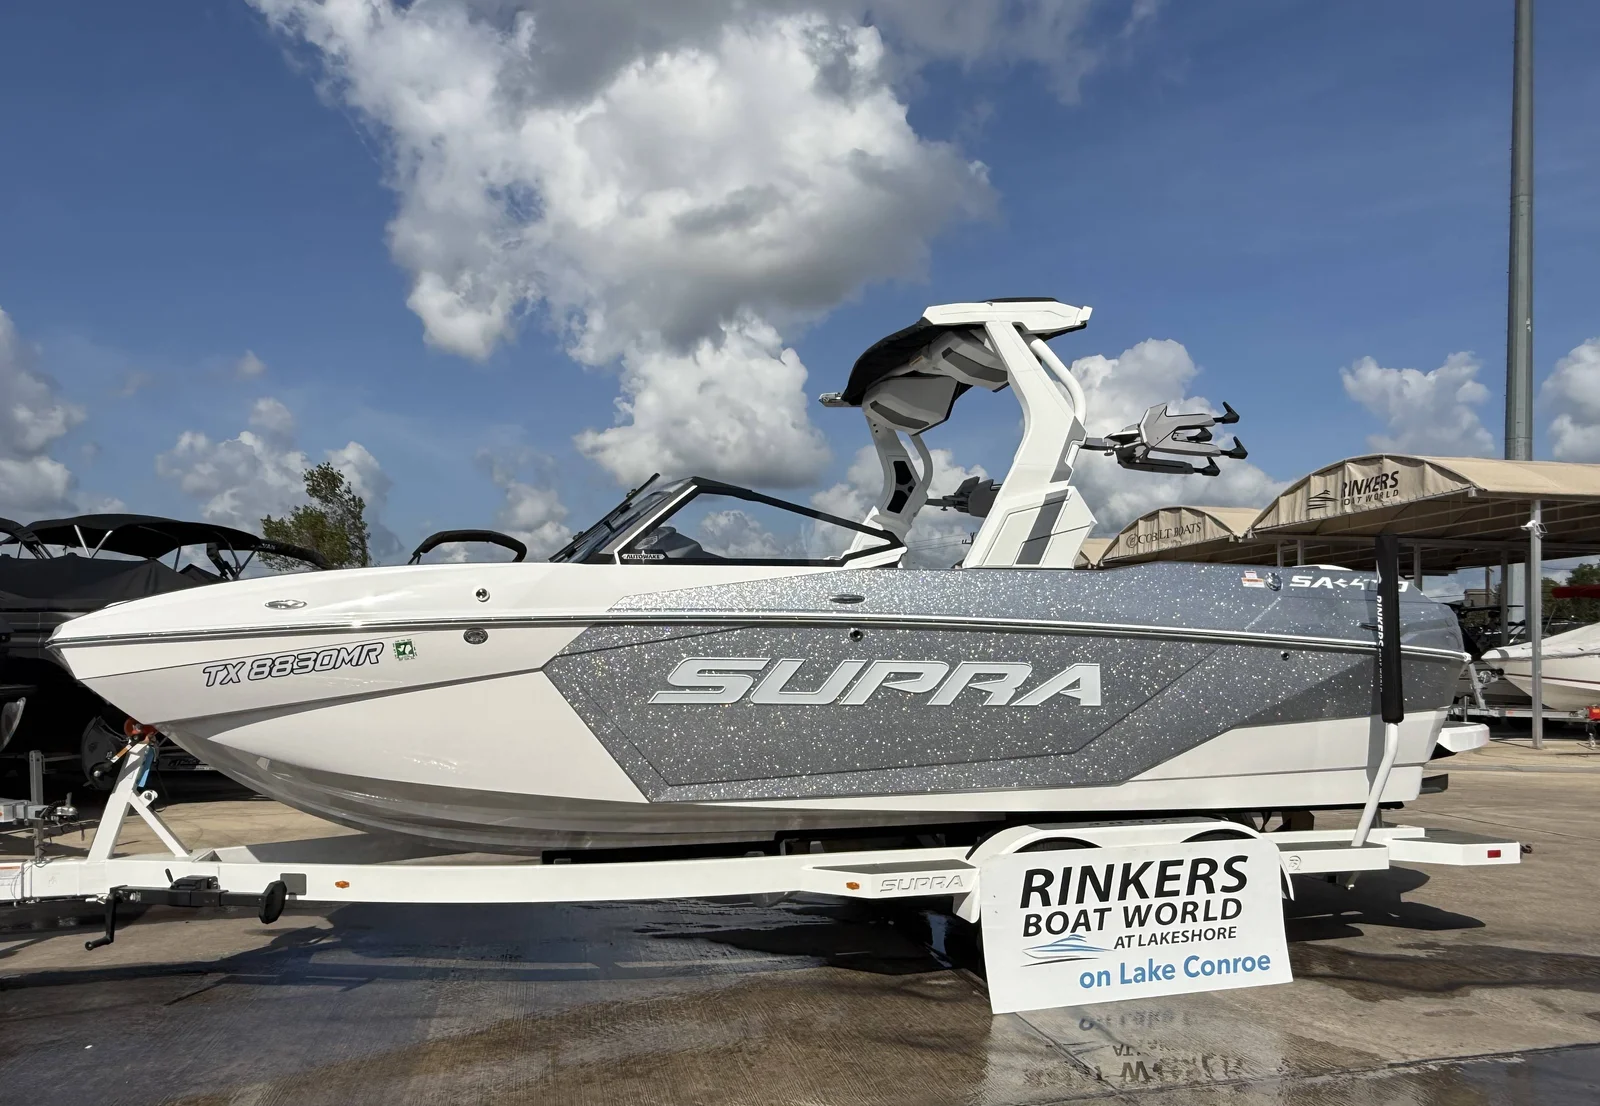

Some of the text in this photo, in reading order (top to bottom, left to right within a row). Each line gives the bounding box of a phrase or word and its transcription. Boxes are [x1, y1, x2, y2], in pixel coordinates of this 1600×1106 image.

[1341, 471, 1399, 498] RINKERS
[1343, 489, 1399, 506] OAT WORLD
[1174, 522, 1202, 537] BOATS
[203, 661, 246, 687] TX
[248, 642, 384, 681] 8830MR
[648, 657, 1101, 706] SUPRA
[880, 875, 963, 892] SUPRA
[1020, 855, 1248, 908] RINKERS
[1023, 898, 1242, 937] BOAT WORLD
[1114, 926, 1237, 949] AT LAKESHORE
[1079, 955, 1271, 988] on Lake Conroe
